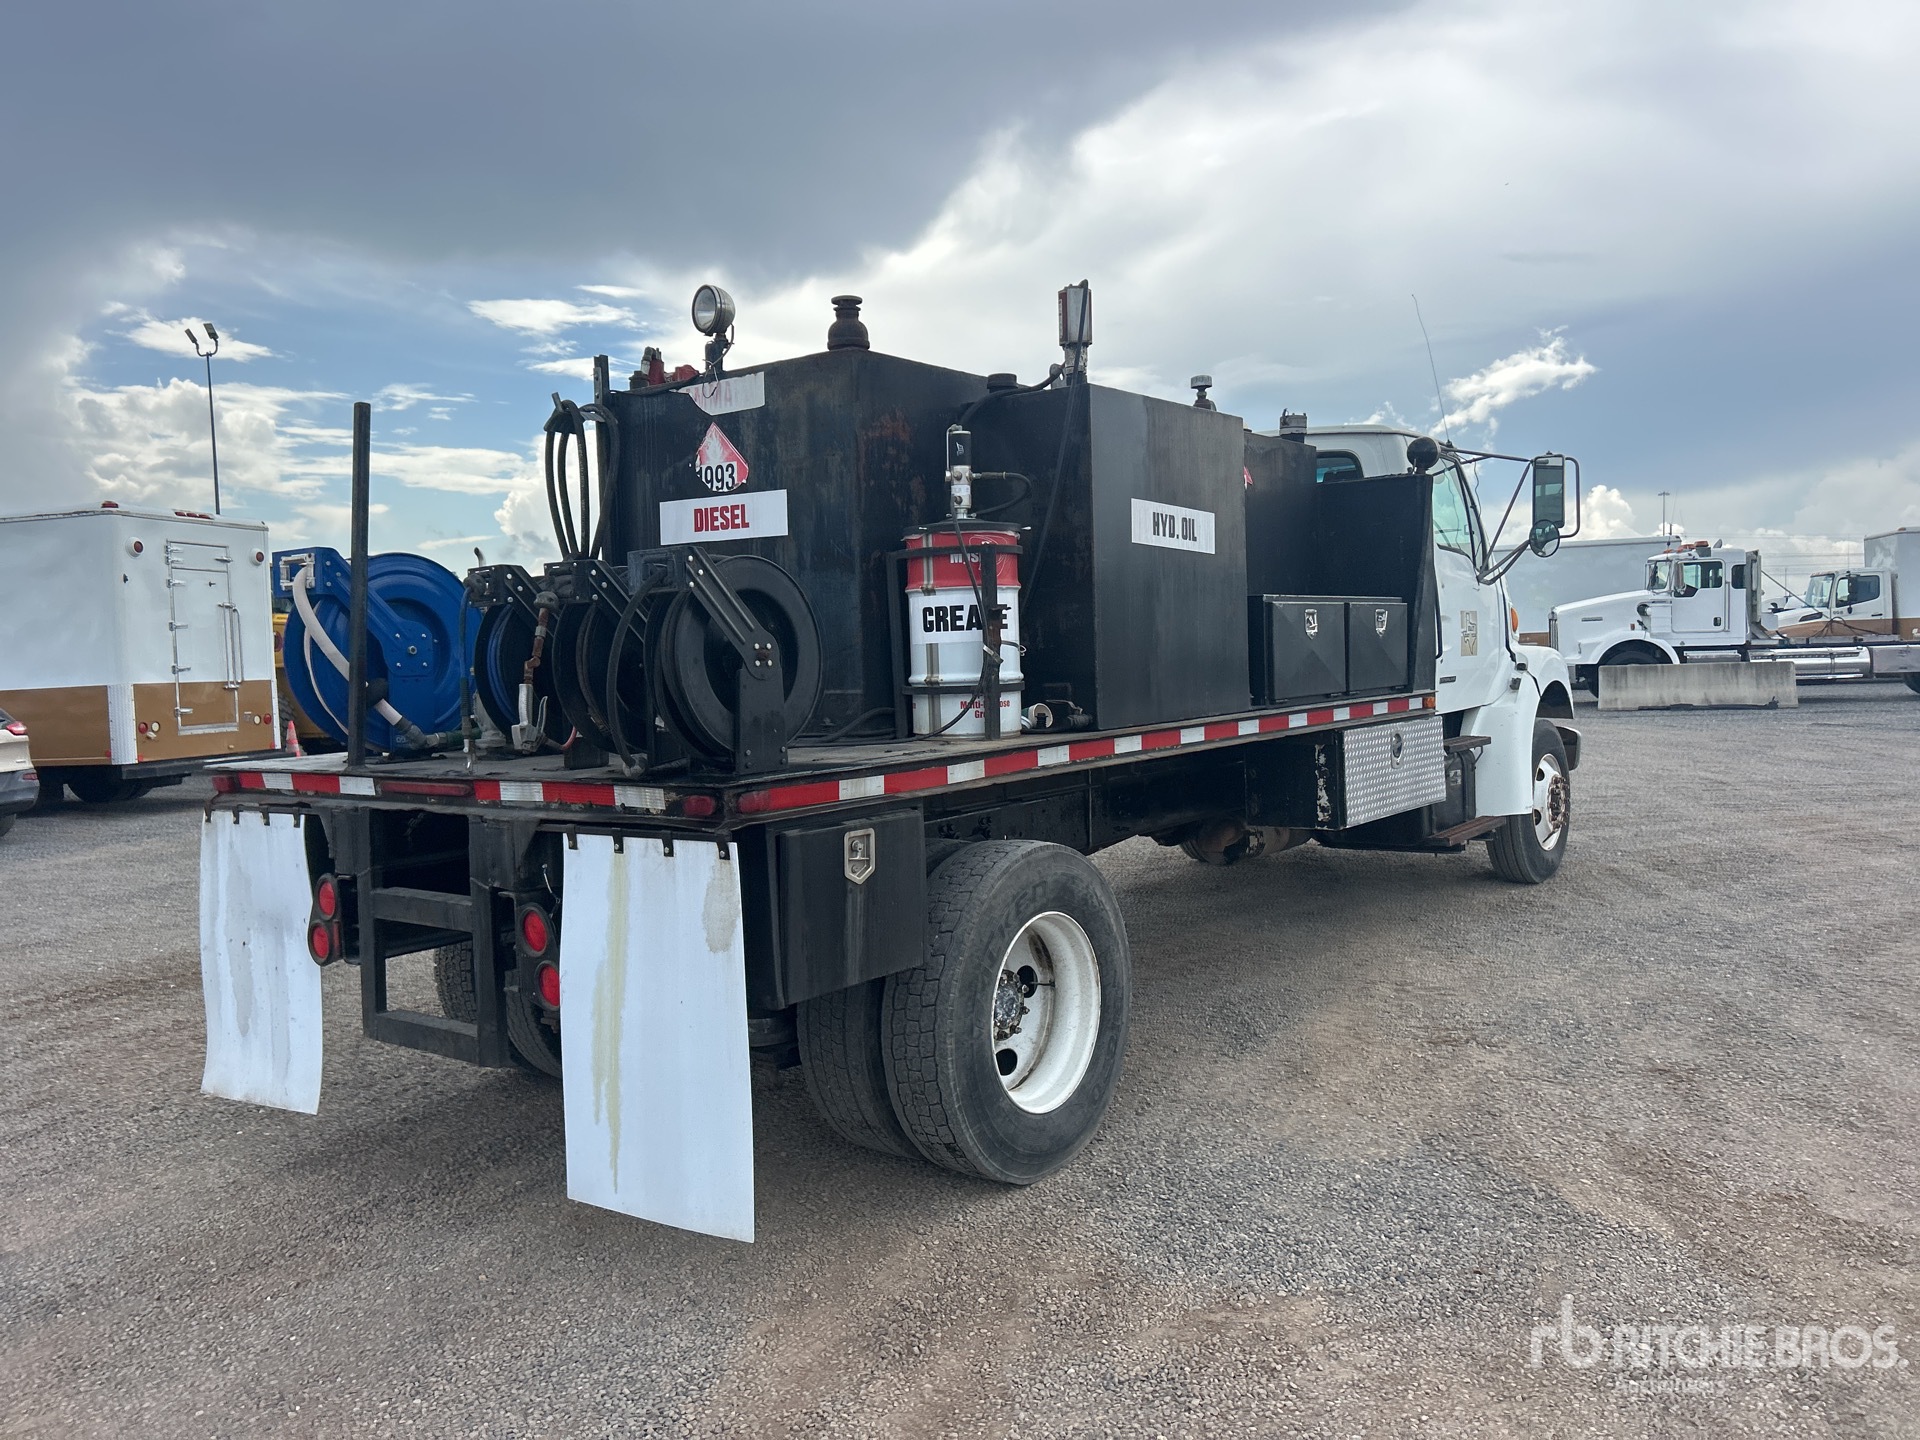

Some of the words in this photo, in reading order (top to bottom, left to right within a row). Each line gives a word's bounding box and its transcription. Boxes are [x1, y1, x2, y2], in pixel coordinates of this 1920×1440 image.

[694, 504, 749, 532] DIESEL
[1153, 512, 1179, 539] HYD.
[1182, 517, 1197, 542] OIL
[923, 604, 1008, 632] GREAE
